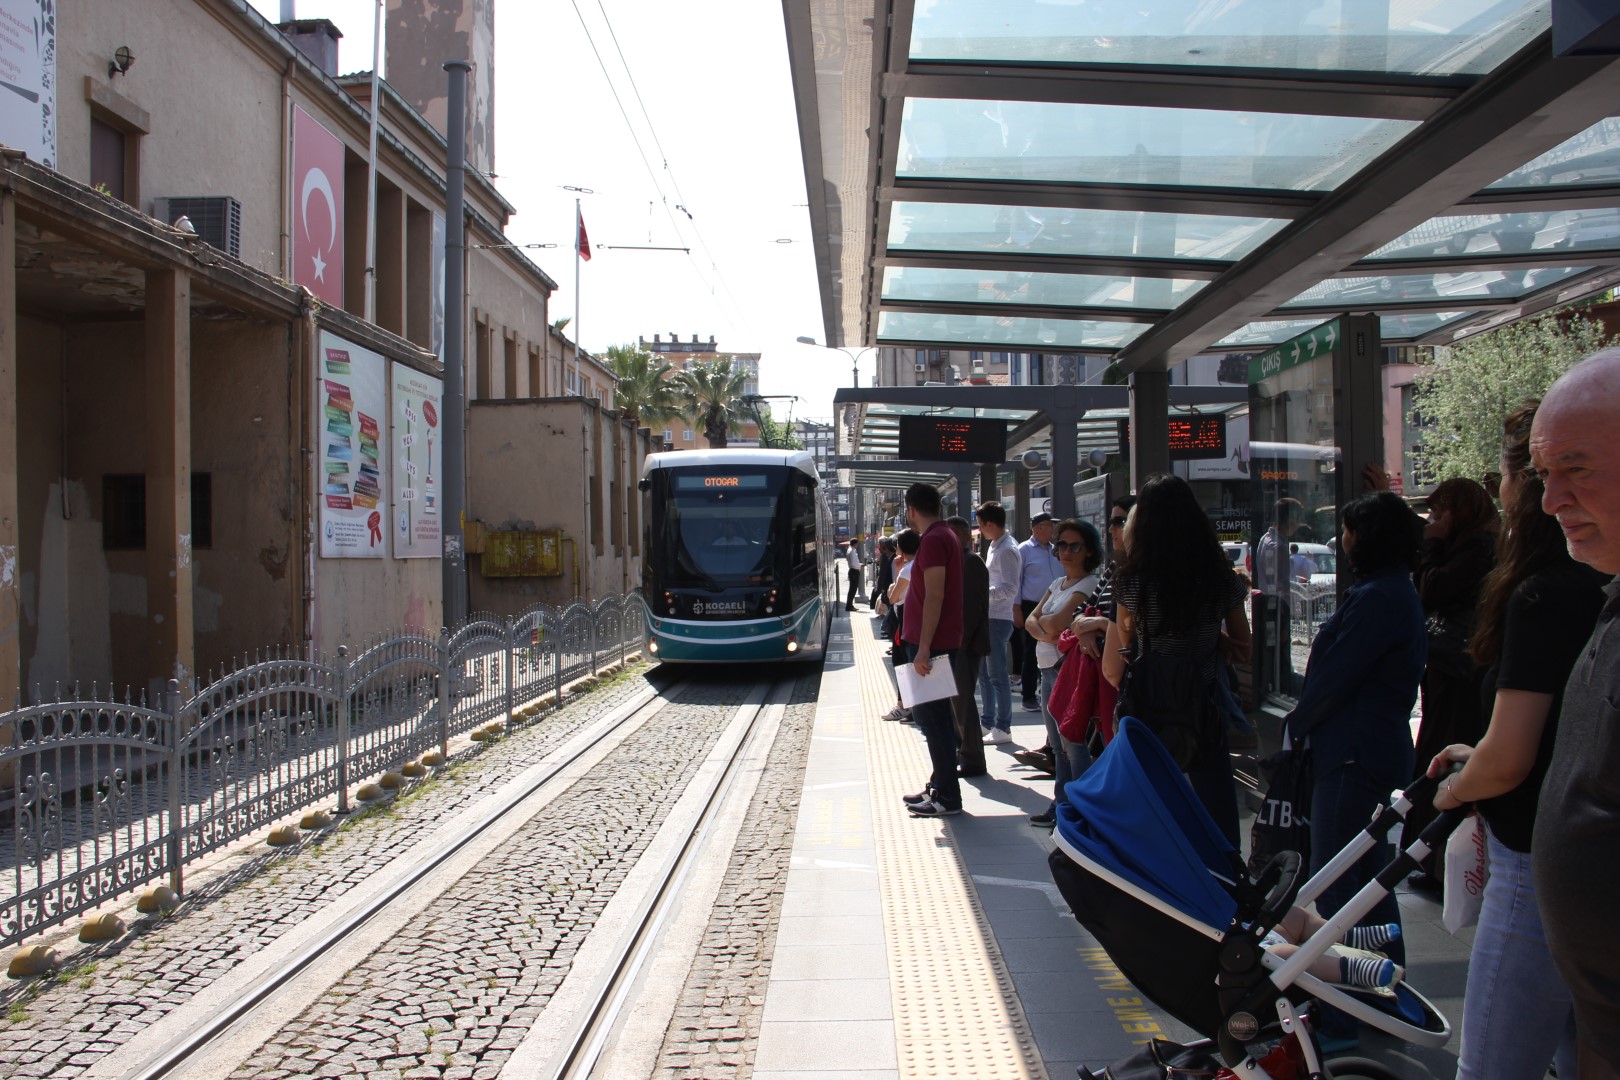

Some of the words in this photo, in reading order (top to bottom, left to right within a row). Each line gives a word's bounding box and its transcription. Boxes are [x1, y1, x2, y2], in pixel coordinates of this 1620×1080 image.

[1261, 350, 1281, 378] ÇIKIŞ
[704, 477, 739, 487] OTOGAR
[402, 490, 414, 499] ALES
[1215, 520, 1252, 531] SEMPRE
[705, 601, 746, 610] KOCAELİ
[1256, 799, 1292, 828] LTB
